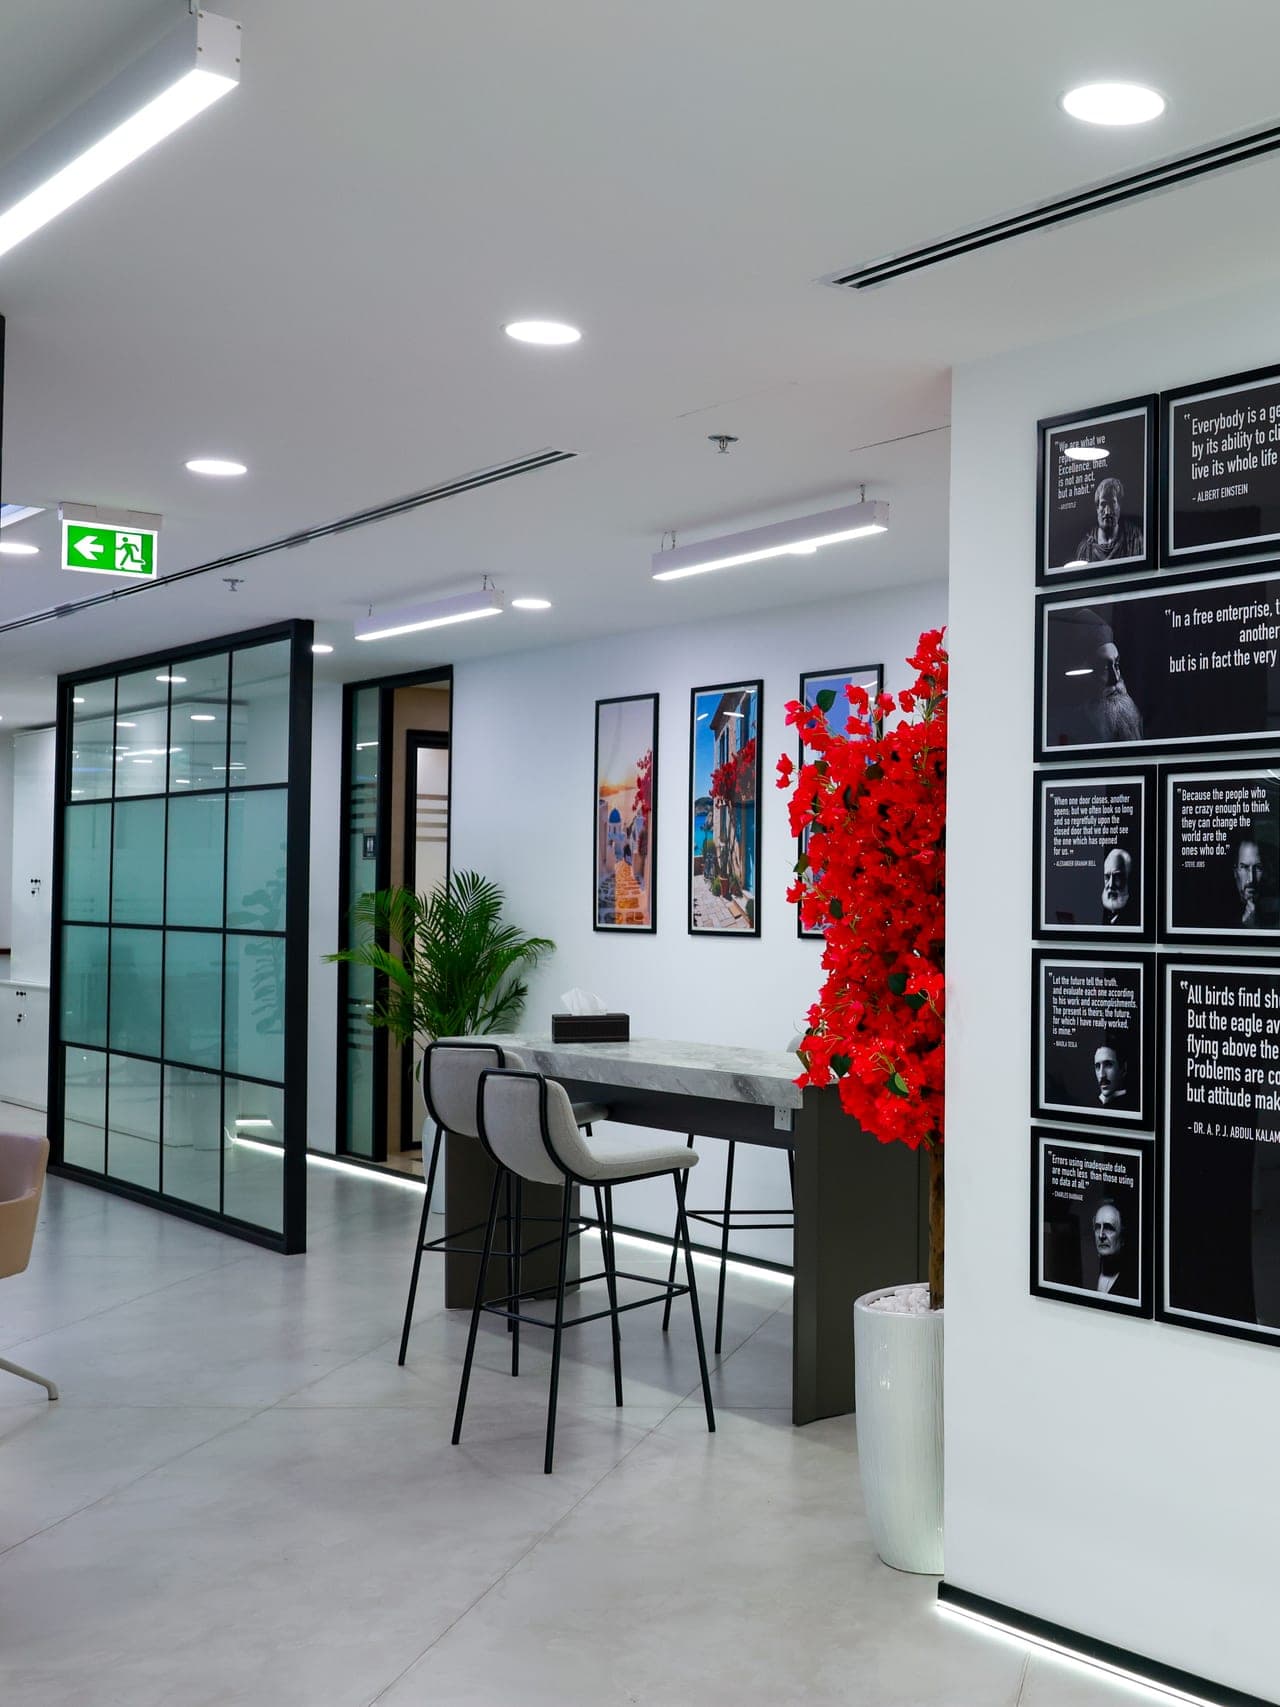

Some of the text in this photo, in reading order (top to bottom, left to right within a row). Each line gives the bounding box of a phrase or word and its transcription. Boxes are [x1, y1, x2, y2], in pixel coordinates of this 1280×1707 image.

[1247, 406, 1257, 424] is
[1259, 408, 1266, 421] a
[1197, 483, 1248, 502] ALBERT EINSTEIN
[1239, 623, 1280, 643] another
[1212, 788, 1224, 800] the
[1225, 787, 1249, 803] people
[1250, 786, 1266, 799] who
[1205, 985, 1235, 1006] birds
[1238, 987, 1261, 1008] find
[1186, 1082, 1205, 1103] but
[1207, 1086, 1251, 1108] attitude
